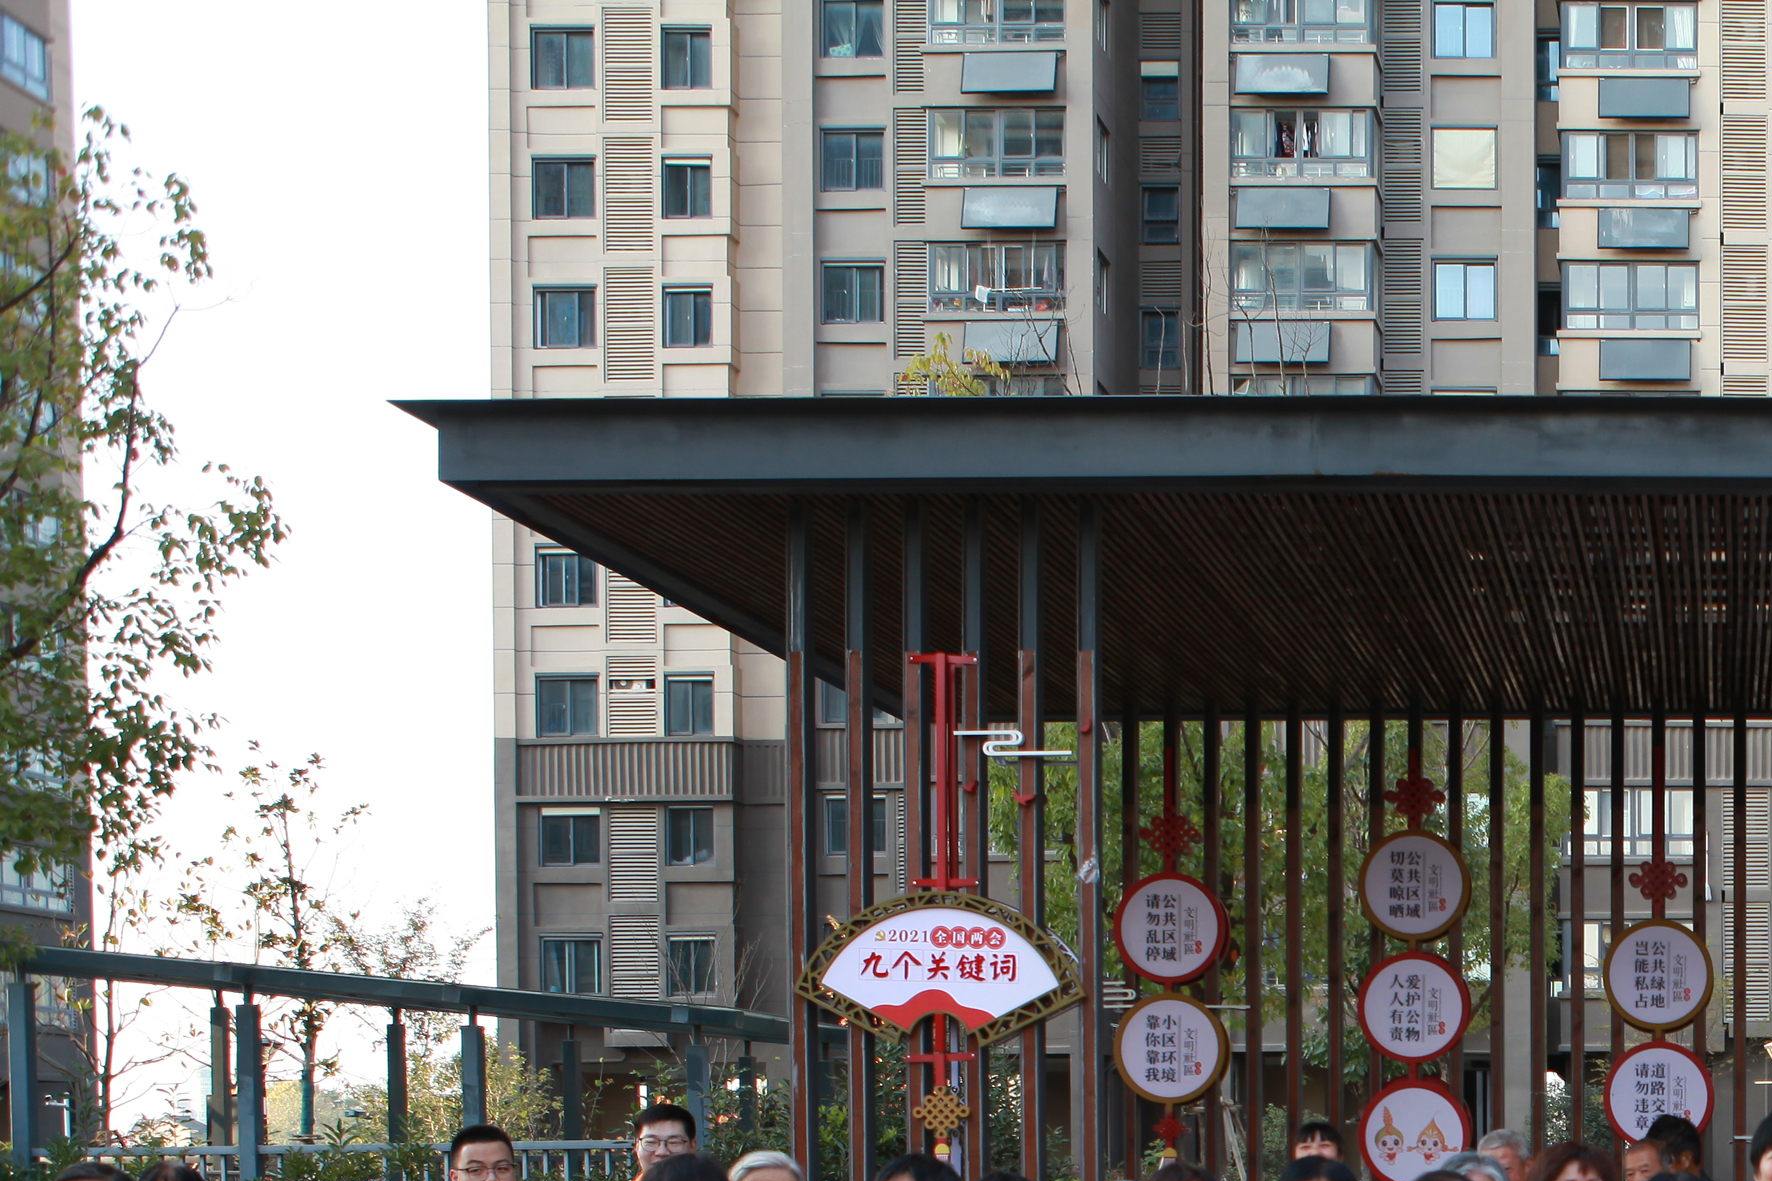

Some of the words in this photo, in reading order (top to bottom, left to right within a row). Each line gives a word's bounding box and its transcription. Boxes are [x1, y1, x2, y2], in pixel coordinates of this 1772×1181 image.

[1389, 850, 1405, 918] 切莫晾晒
[1405, 851, 1421, 918] 公共区域
[1146, 894, 1161, 961] 请勿乱停
[1162, 894, 1177, 961] 公共区域
[861, 951, 1016, 982] 九个关键词
[1635, 941, 1649, 1008] 岂能私占
[1651, 941, 1666, 1008] 公共绿地
[1390, 974, 1404, 1041] 人人有责
[1405, 975, 1421, 1041] 爱护公物
[1145, 1015, 1160, 1082] 靠你靠我
[1161, 1015, 1177, 1082] 小区环境
[1635, 1063, 1648, 1130] 请勿违章
[1651, 1063, 1665, 1122] 道路交
